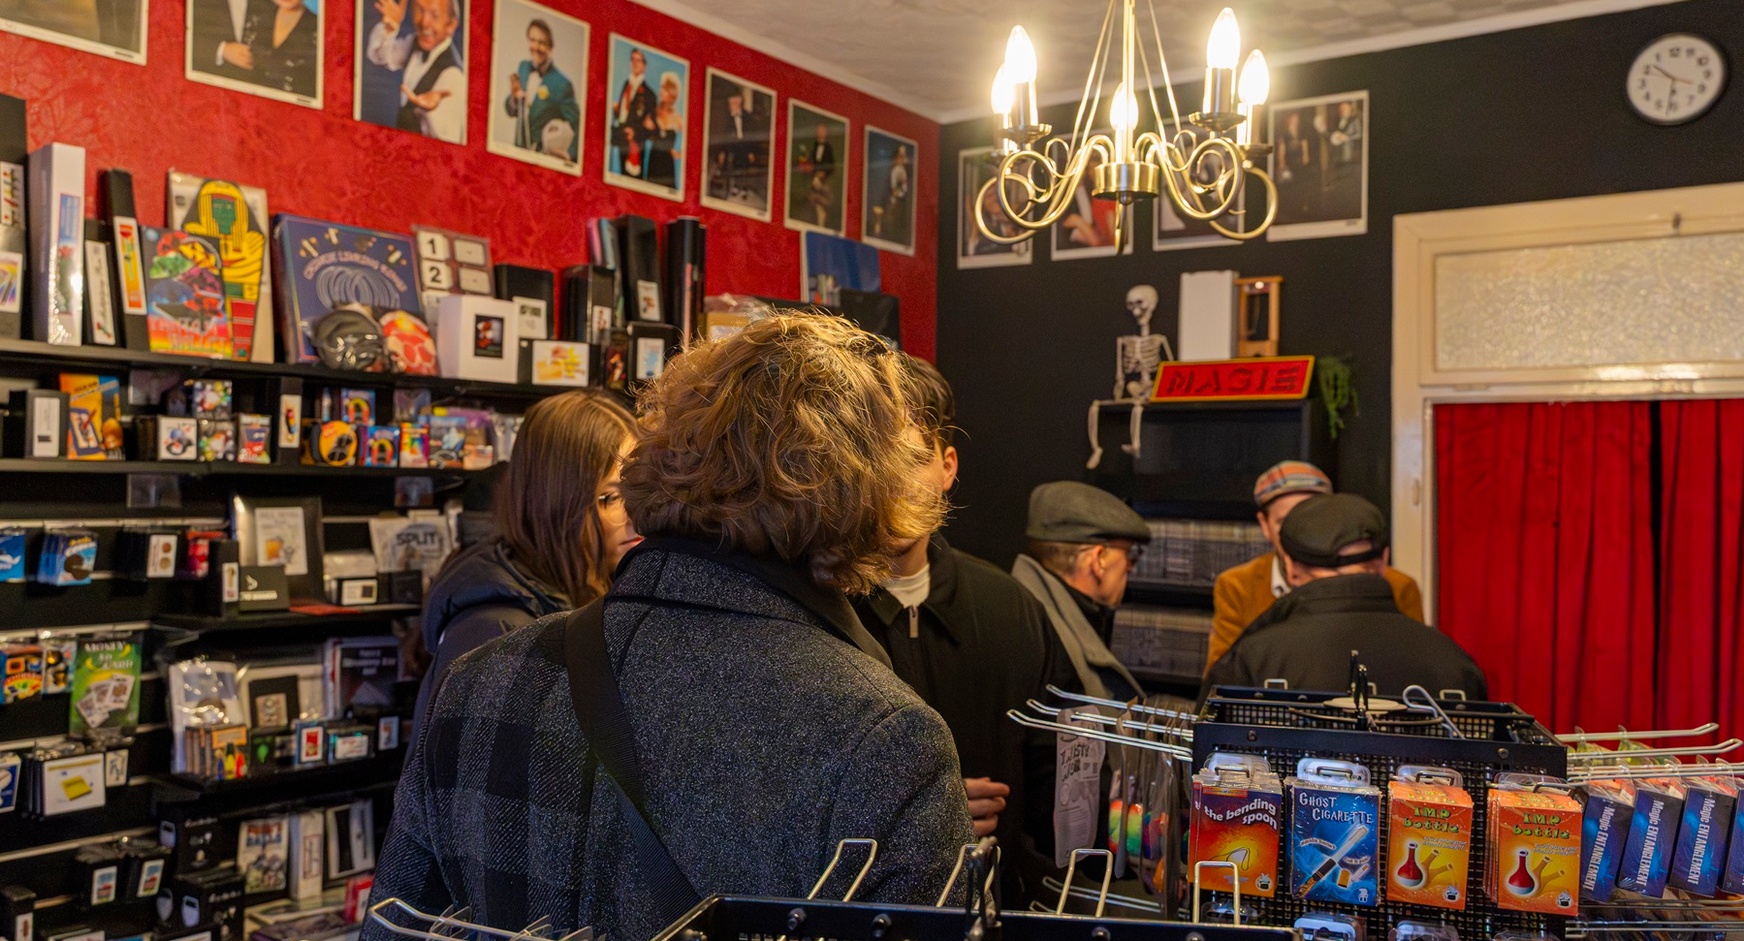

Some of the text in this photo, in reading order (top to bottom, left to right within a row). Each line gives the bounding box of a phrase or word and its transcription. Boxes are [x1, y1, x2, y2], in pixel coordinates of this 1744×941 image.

[427, 237, 437, 255] 1
[429, 266, 444, 284] 2
[1166, 366, 1300, 393] MAGIE
[1299, 792, 1338, 808] GHOST
[1204, 804, 1224, 822] the
[1225, 798, 1277, 817] bending
[1312, 808, 1374, 825] CIGARETTE
[1414, 806, 1452, 821] IMP
[1242, 812, 1279, 831] spoon
[1403, 817, 1459, 834] bottle
[1523, 812, 1562, 827] IMP
[1513, 824, 1570, 840] bottle
[1582, 806, 1616, 892] Magic ENTANGLEMENT
[1635, 799, 1665, 887] Magic ENTANGLEMENT
[1687, 797, 1716, 886] Magic ENTANGLEMENT
